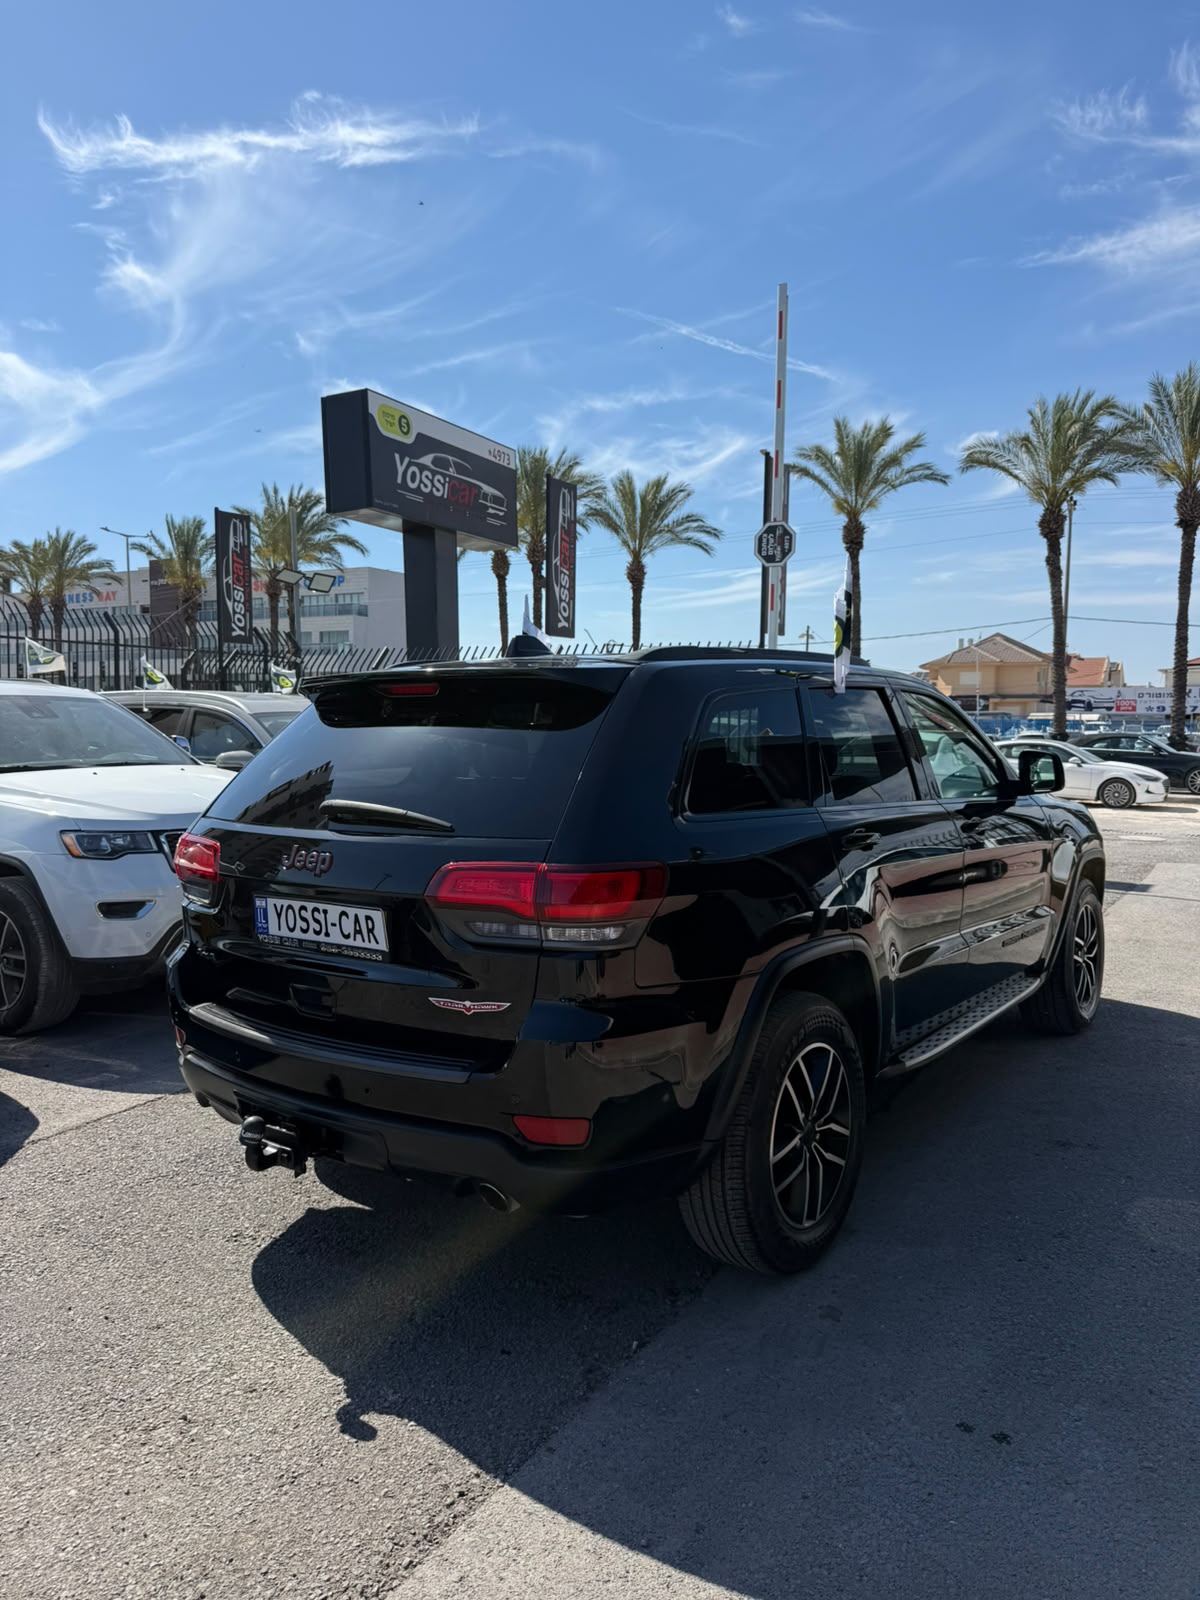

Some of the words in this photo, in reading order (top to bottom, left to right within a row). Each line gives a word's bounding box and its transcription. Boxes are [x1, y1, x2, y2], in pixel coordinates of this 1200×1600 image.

[281, 844, 334, 878] Jeep
[257, 908, 266, 923] IL
[273, 903, 380, 945] YOSSI-CAR
